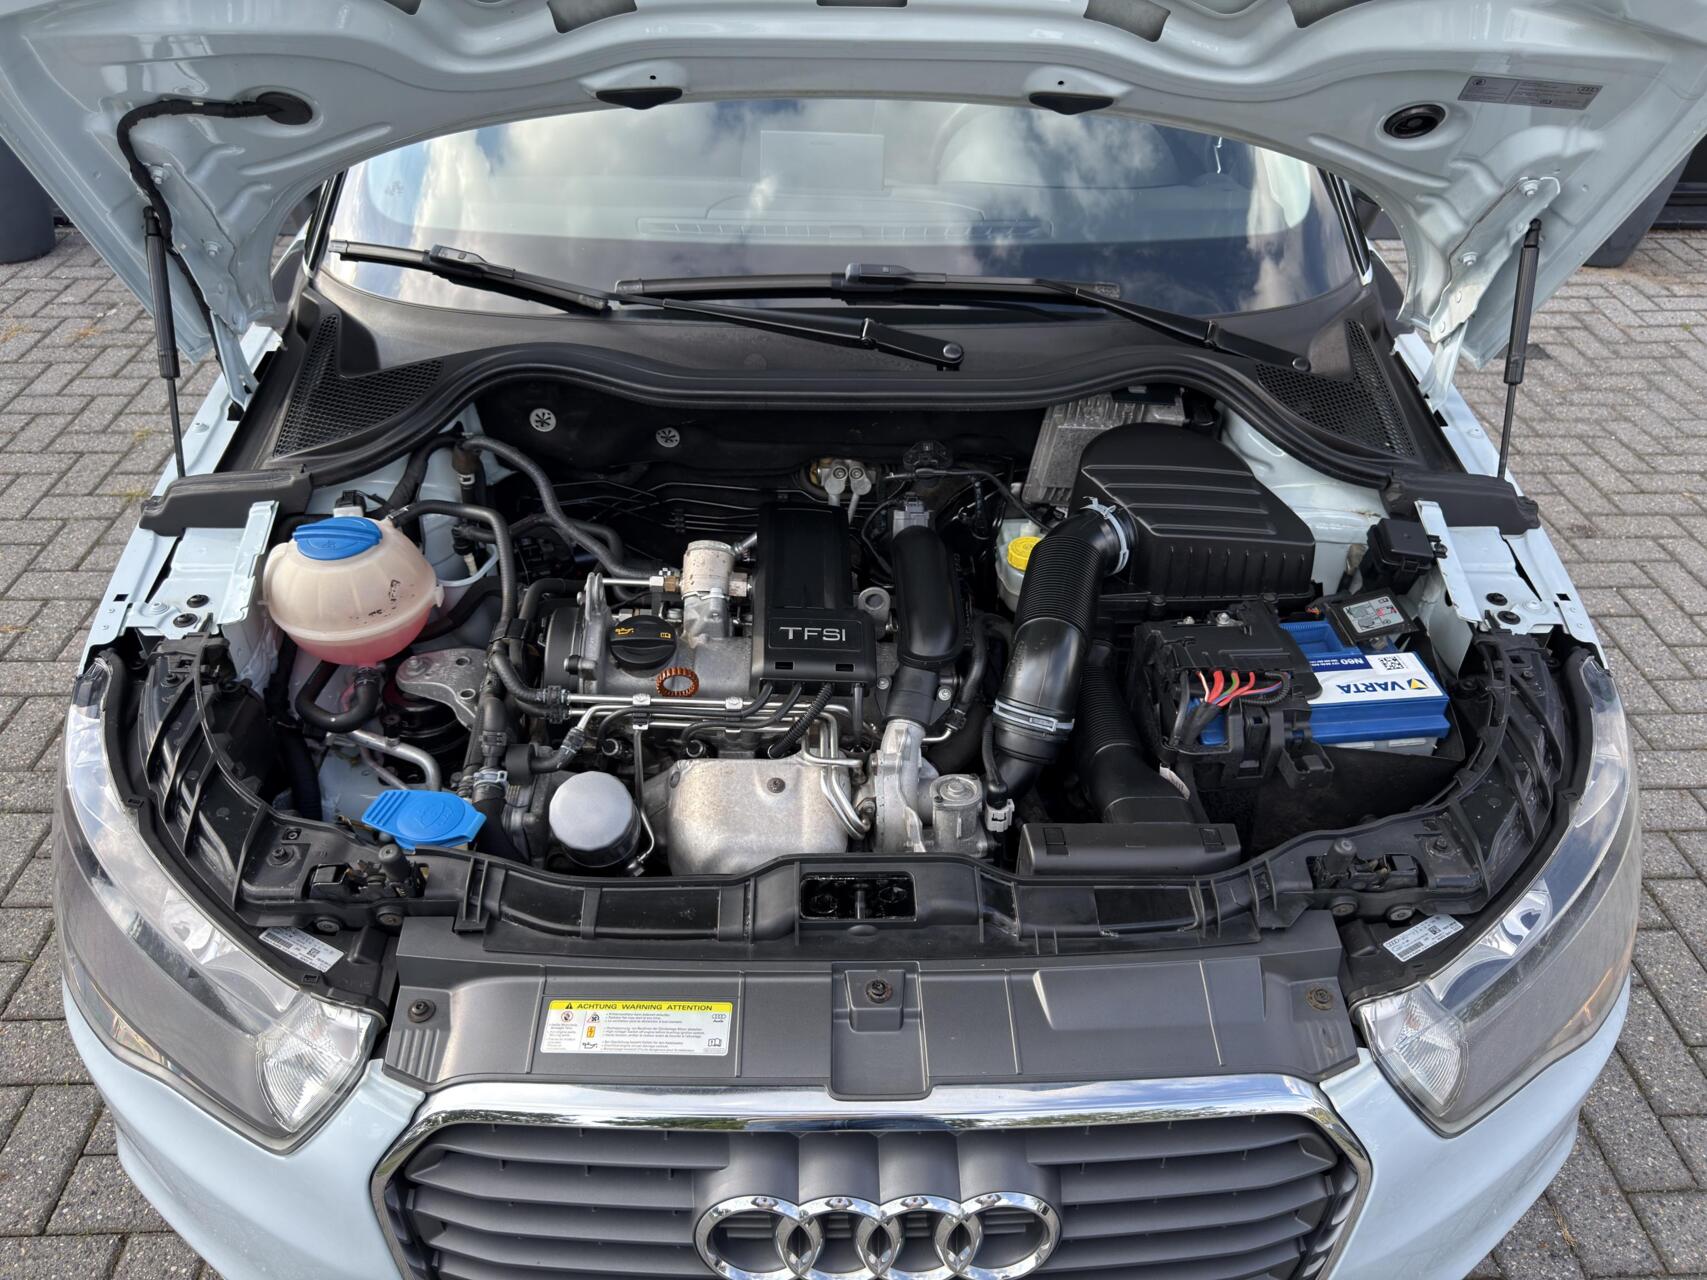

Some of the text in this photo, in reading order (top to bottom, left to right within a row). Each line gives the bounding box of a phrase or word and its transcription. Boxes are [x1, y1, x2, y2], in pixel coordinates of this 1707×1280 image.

[779, 626, 846, 641] TFSI
[1337, 681, 1406, 694] VARTA
[622, 1003, 663, 1011] WARNING
